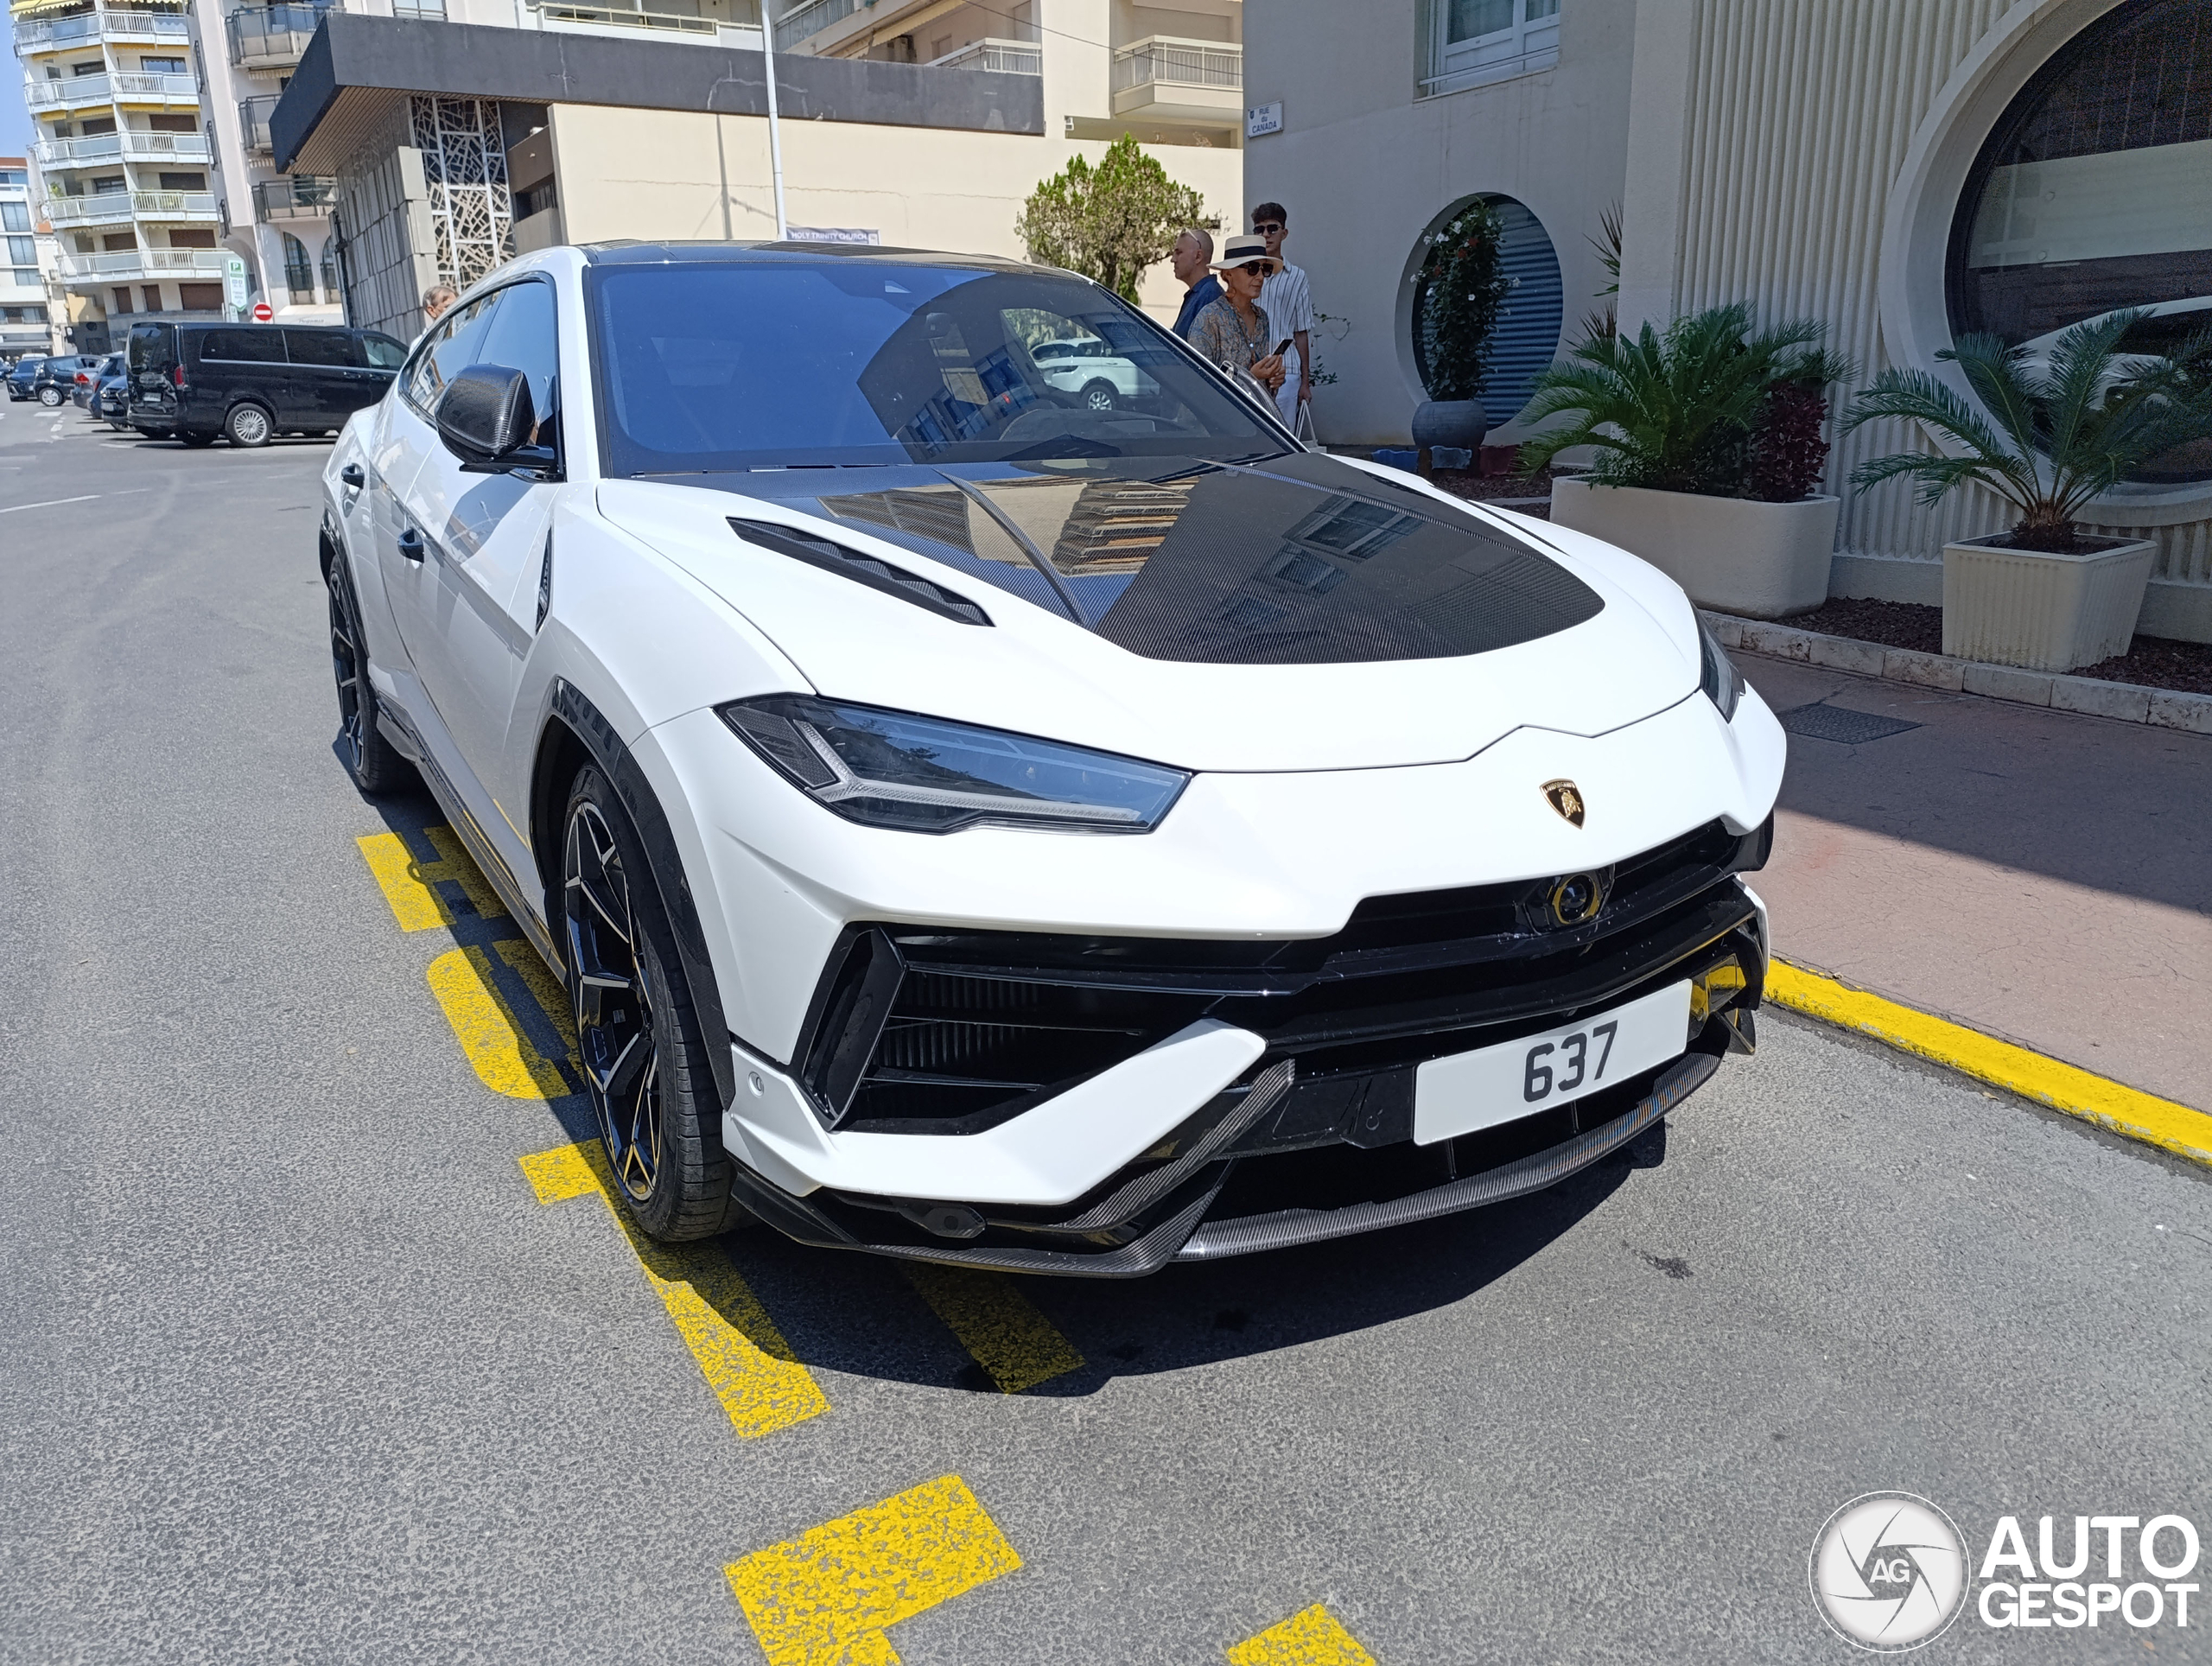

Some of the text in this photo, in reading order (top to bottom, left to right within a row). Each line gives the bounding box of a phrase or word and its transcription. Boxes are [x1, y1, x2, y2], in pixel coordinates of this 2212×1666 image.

[1259, 106, 1269, 115] RUE
[1251, 120, 1277, 134] CANADA
[791, 232, 810, 240] HOLY
[811, 232, 838, 240] TRINITY
[1522, 1019, 1618, 1103] 637
